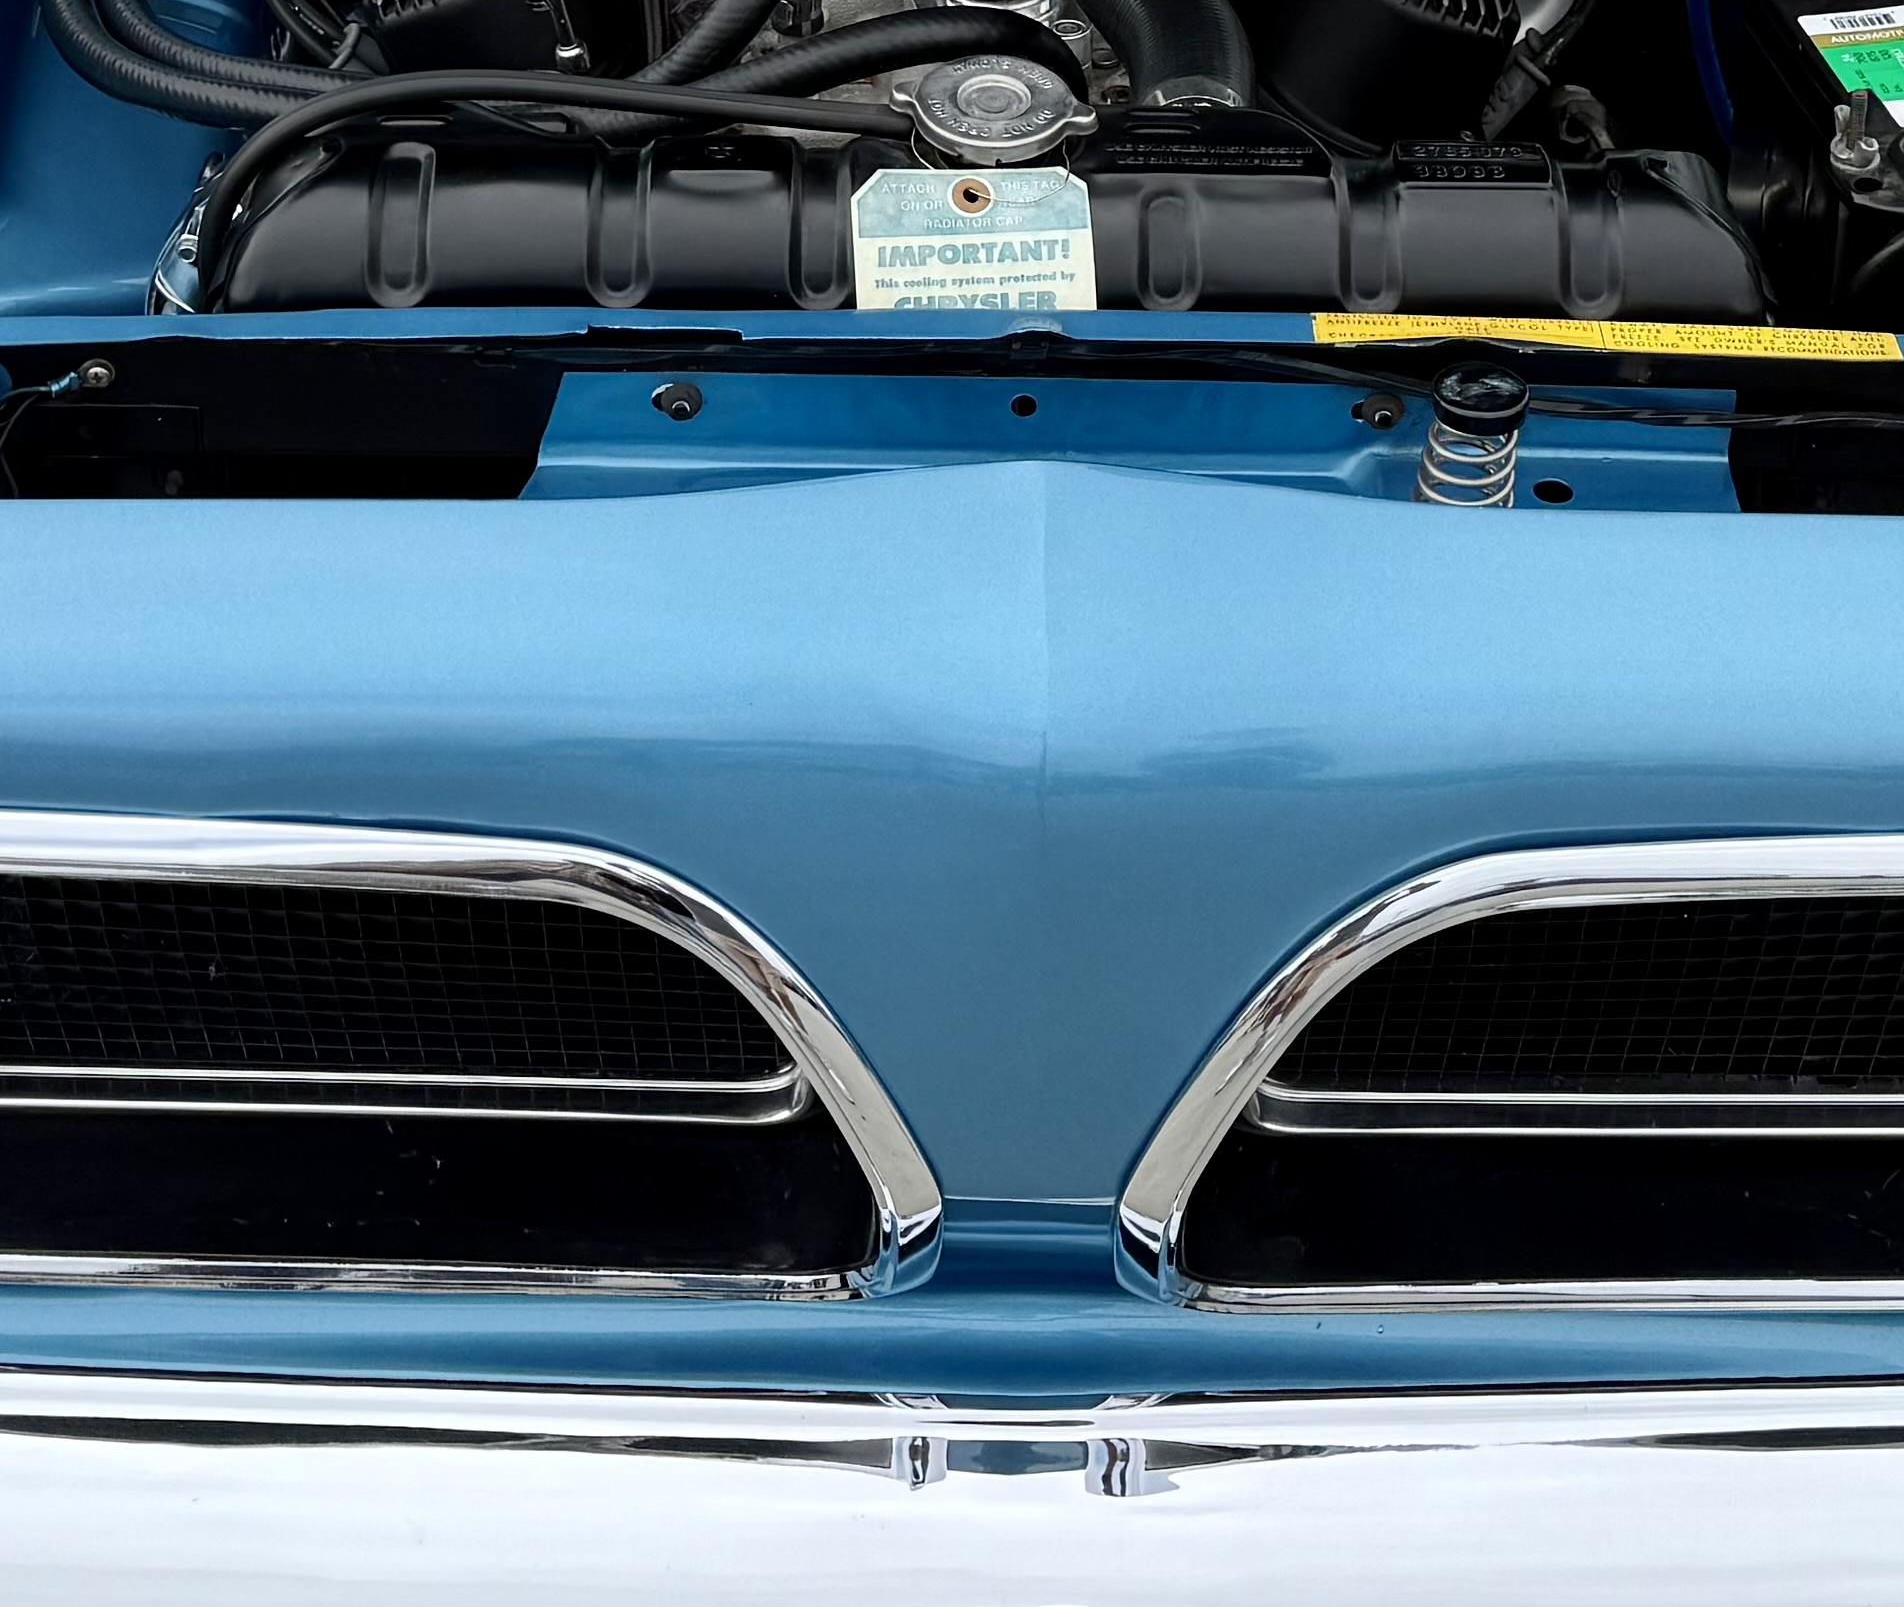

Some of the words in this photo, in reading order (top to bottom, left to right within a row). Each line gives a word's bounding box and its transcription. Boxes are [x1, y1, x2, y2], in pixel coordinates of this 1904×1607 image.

[882, 183, 935, 194] ATTACH
[1000, 180, 1030, 191] THIS
[1034, 180, 1061, 190] TAG
[901, 200, 920, 211] ON
[924, 199, 943, 210] OR
[924, 217, 992, 229] RADIATOR
[996, 216, 1023, 227] CAP
[877, 239, 1071, 268] IMPORTANT!
[875, 278, 900, 289] This
[903, 275, 947, 289] cooling
[951, 274, 995, 289] system
[999, 271, 1057, 287] protected
[1061, 269, 1076, 283] by
[894, 290, 1058, 311] CHRYSLER
[1772, 332, 1839, 342] CHRYSLER
[1614, 341, 1680, 349] COOLING
[1785, 340, 1848, 348] MANUAL
